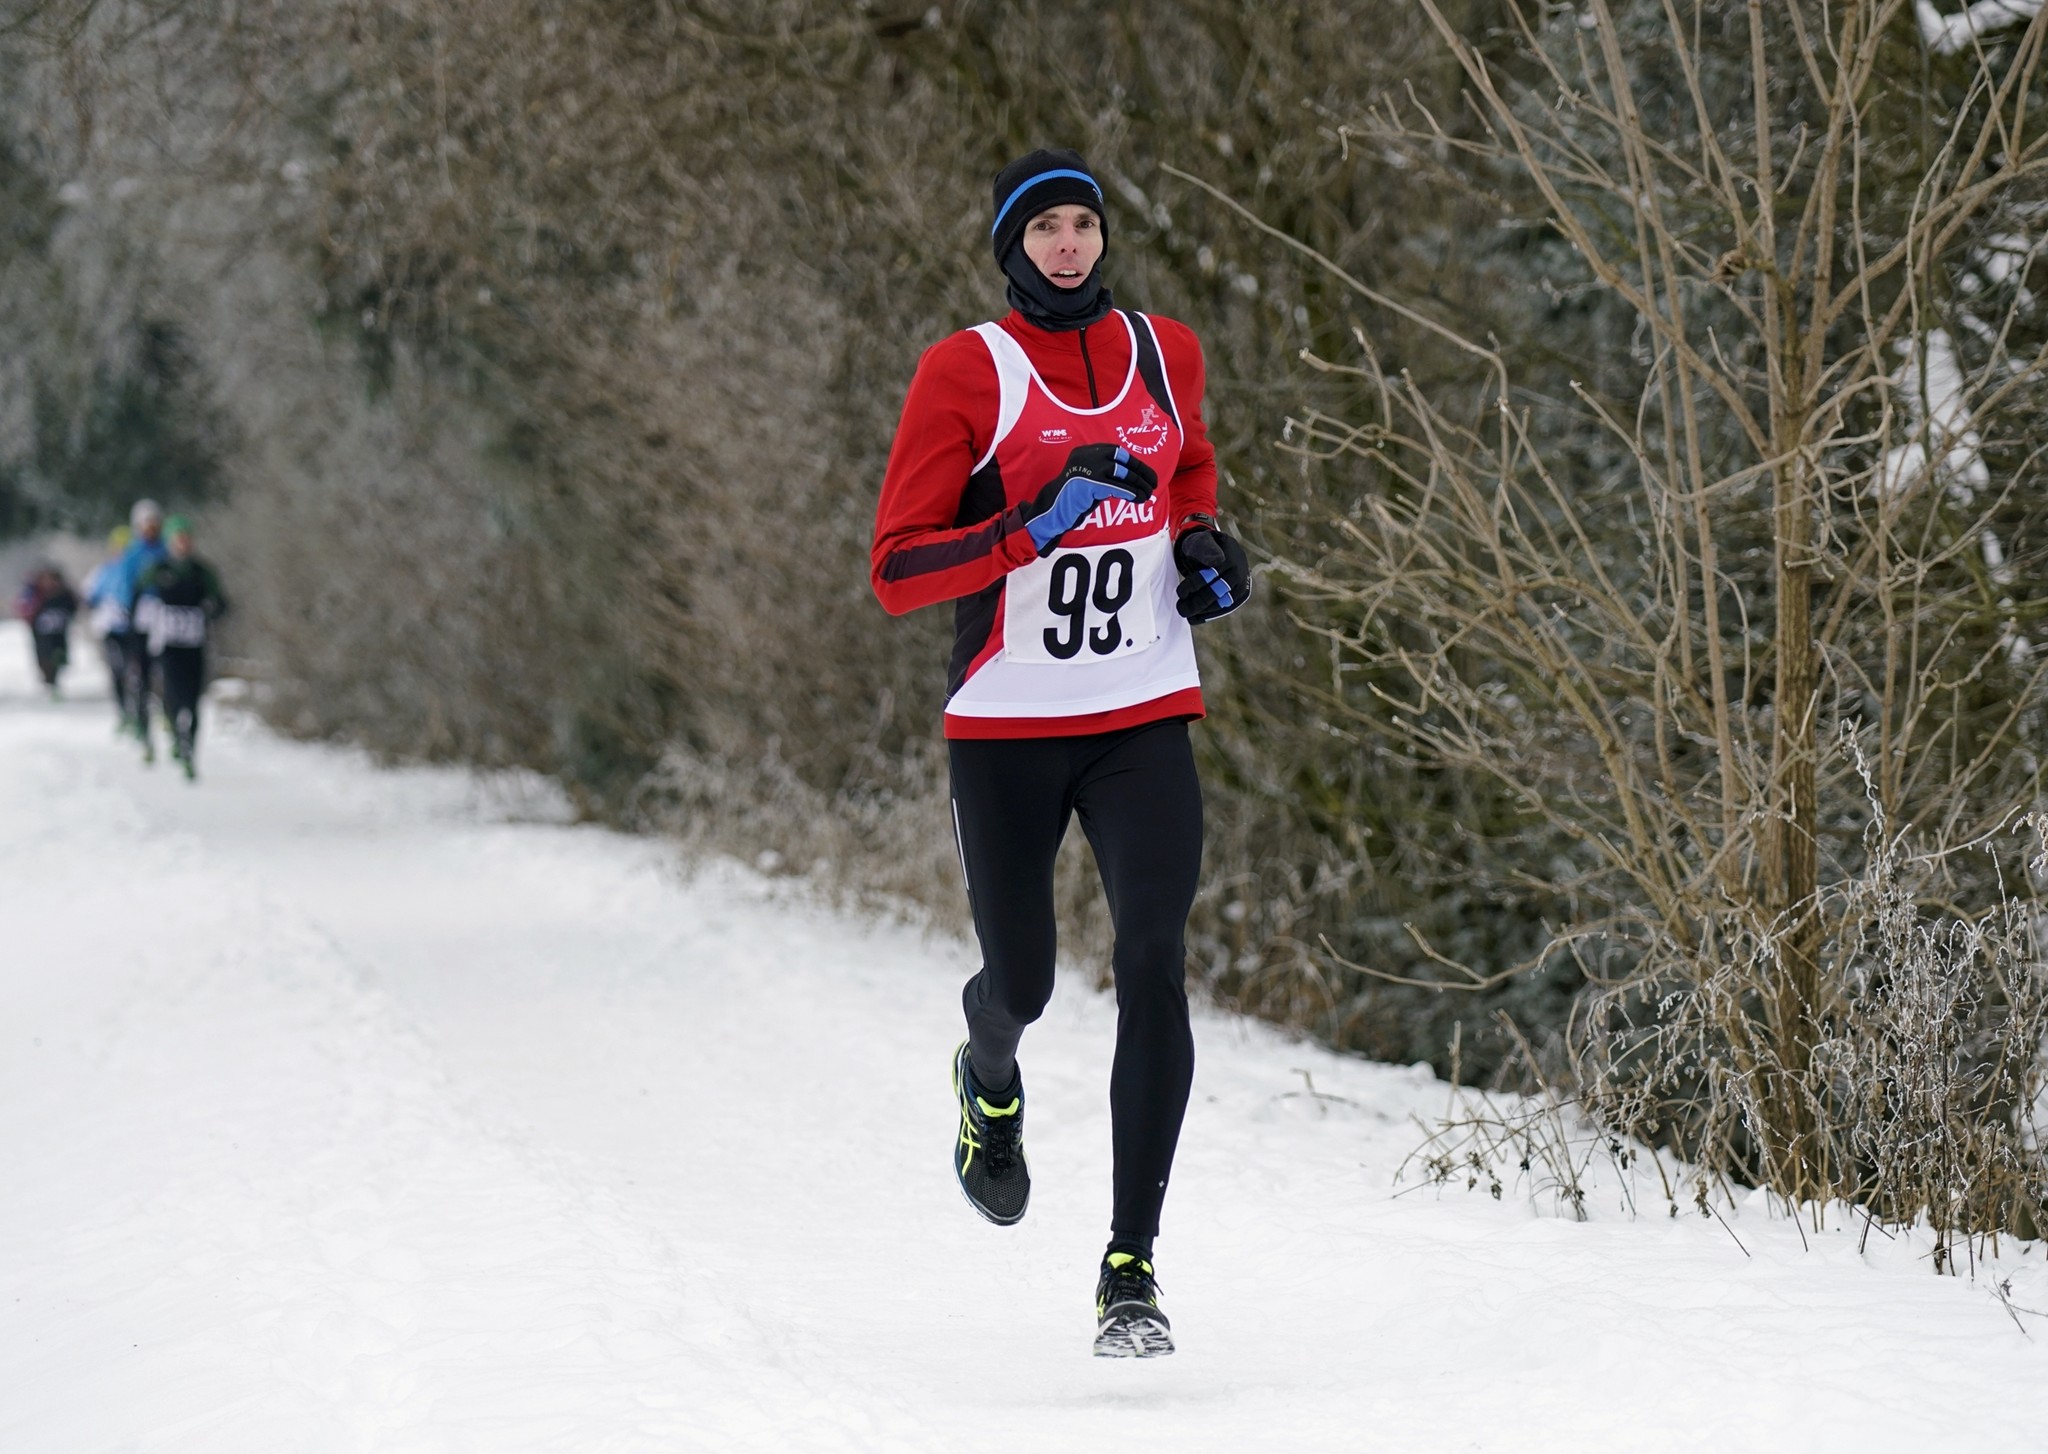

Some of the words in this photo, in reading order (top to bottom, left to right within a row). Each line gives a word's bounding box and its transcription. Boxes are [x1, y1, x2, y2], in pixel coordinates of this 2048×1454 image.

[1115, 421, 1168, 455] RHEINTAL
[1126, 424, 1162, 435] MILA
[1073, 494, 1157, 530] AVAG
